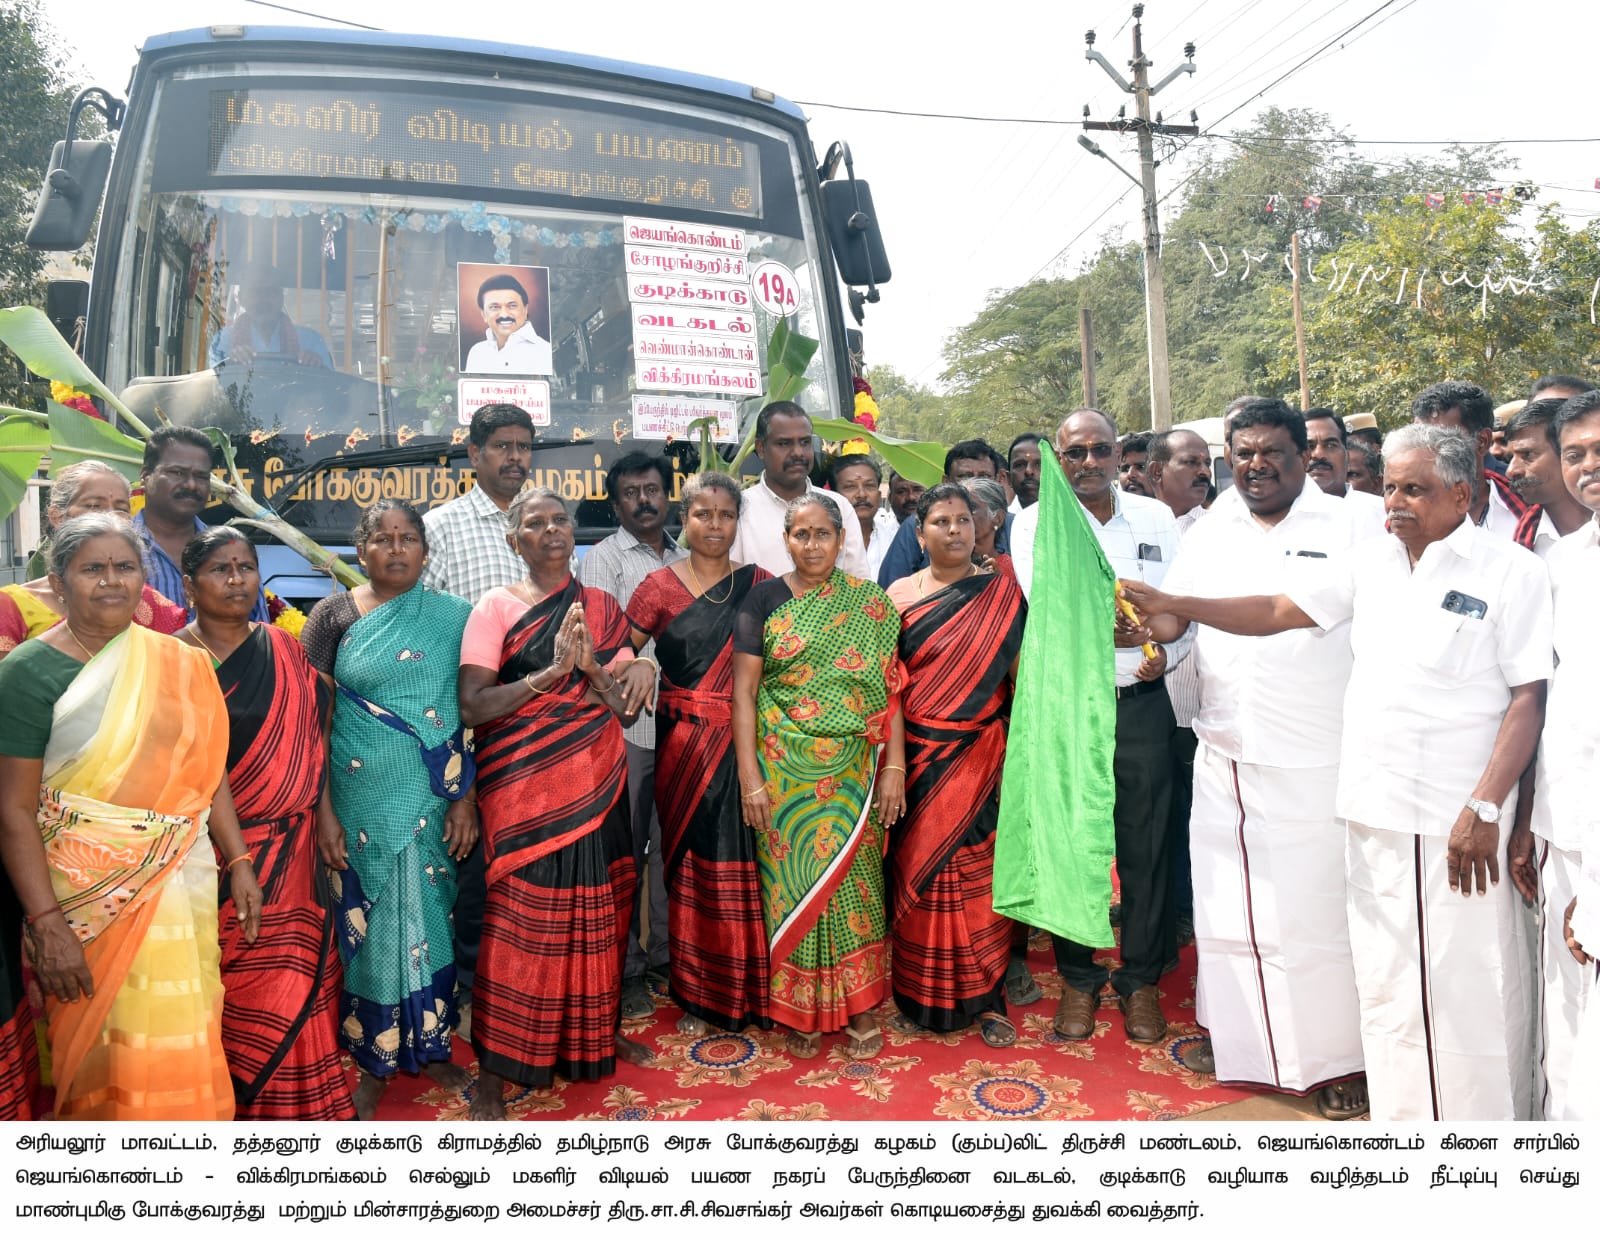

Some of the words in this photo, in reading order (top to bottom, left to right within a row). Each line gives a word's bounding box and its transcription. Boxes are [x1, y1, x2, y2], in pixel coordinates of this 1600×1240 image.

[226, 97, 382, 142] மகளிர்
[407, 108, 573, 152] விடியல்
[596, 132, 742, 168] பயணம்
[630, 226, 743, 251] ஜெயங்கொண்டம்
[631, 251, 745, 275] சோழங்குறிச்சி
[634, 282, 748, 305] குடிக்காடு
[638, 315, 752, 334] வடகடல்
[641, 367, 757, 389] விக்கிரமங்கலம்
